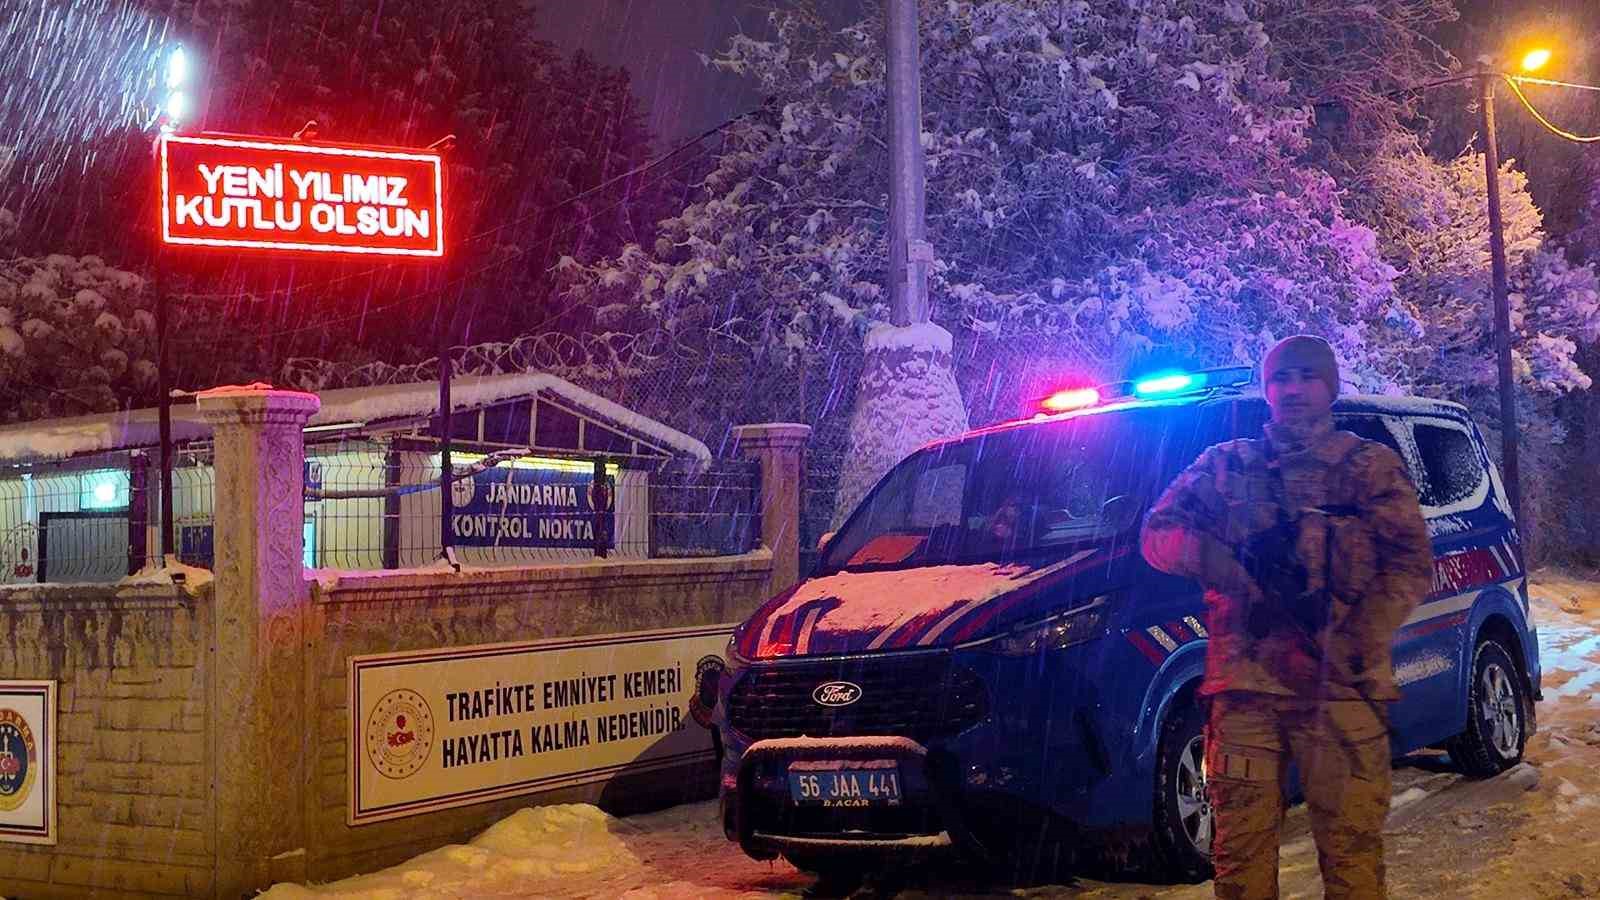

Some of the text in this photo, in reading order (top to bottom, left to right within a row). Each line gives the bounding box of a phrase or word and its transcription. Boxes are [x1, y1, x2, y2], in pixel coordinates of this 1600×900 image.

[198, 163, 408, 207] YENİ YILIMIZ
[175, 195, 430, 238] KUTLU OLSUN
[485, 482, 578, 507] JANDARMA
[451, 513, 594, 541] KONTROL NOKTA
[446, 661, 681, 722] TRAFİKTE EMNİYET KEMERİ
[820, 685, 855, 703] Ford
[442, 729, 523, 769] HAYATTA
[531, 719, 590, 754] KALMA
[799, 773, 898, 797] 56 JAA 441
